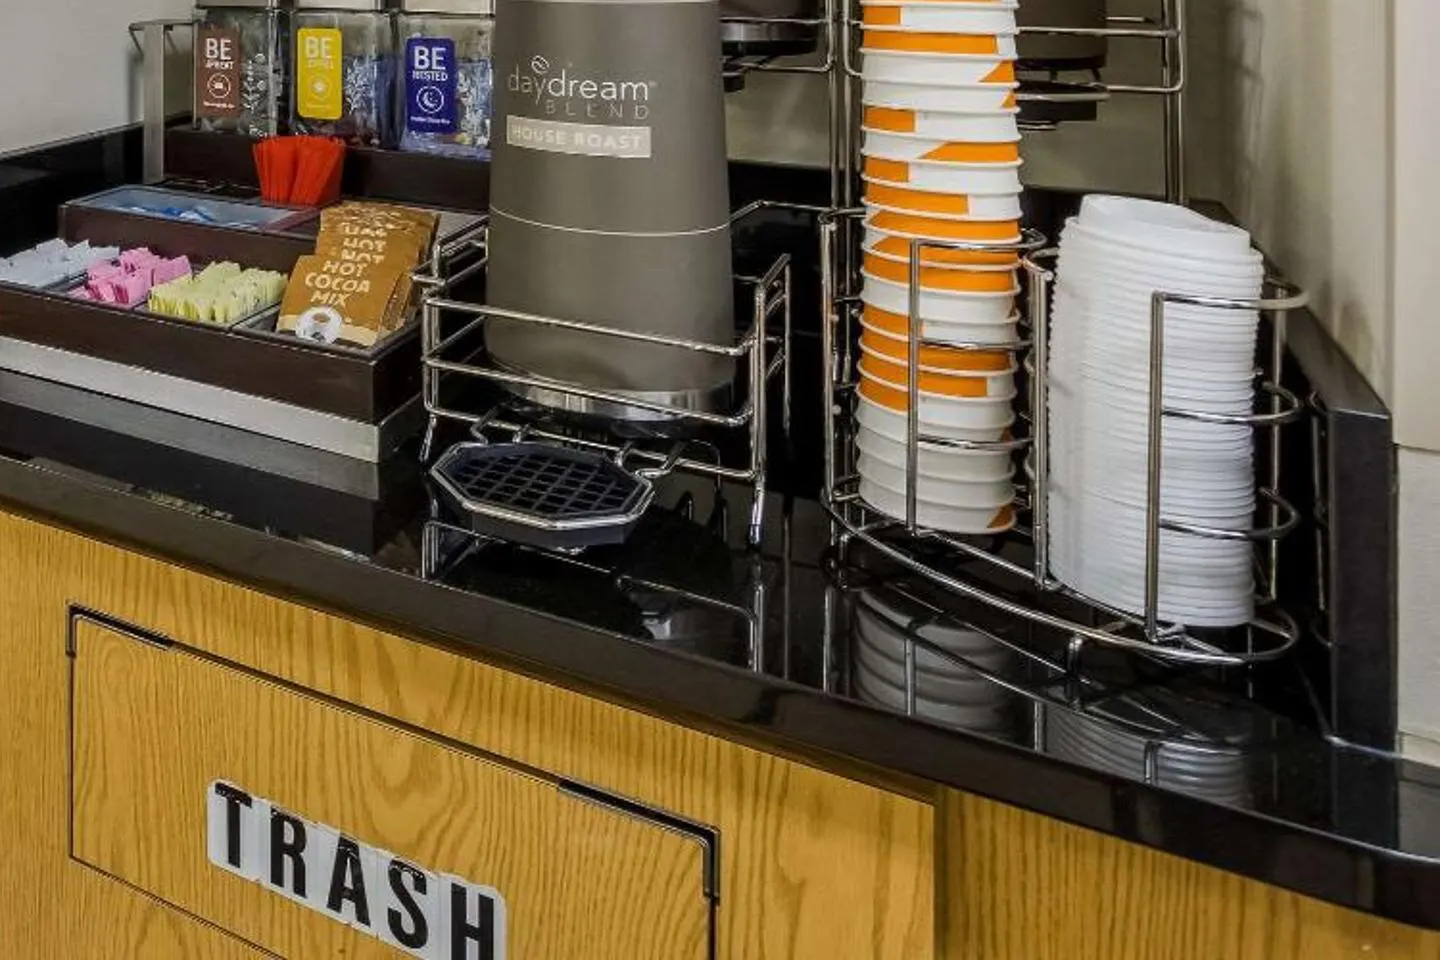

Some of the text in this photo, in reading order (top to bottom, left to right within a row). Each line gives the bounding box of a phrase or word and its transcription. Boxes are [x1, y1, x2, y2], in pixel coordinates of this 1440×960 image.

[205, 37, 233, 60] BE
[305, 35, 333, 59] BE
[413, 45, 447, 71] BE
[508, 63, 650, 104] daydream
[544, 100, 650, 120] BLEND
[511, 122, 641, 150] HOUSE ROAST
[322, 259, 368, 278] HOT
[304, 271, 371, 293] COCOA
[309, 290, 352, 307] MIX
[213, 781, 496, 960] TRASH
